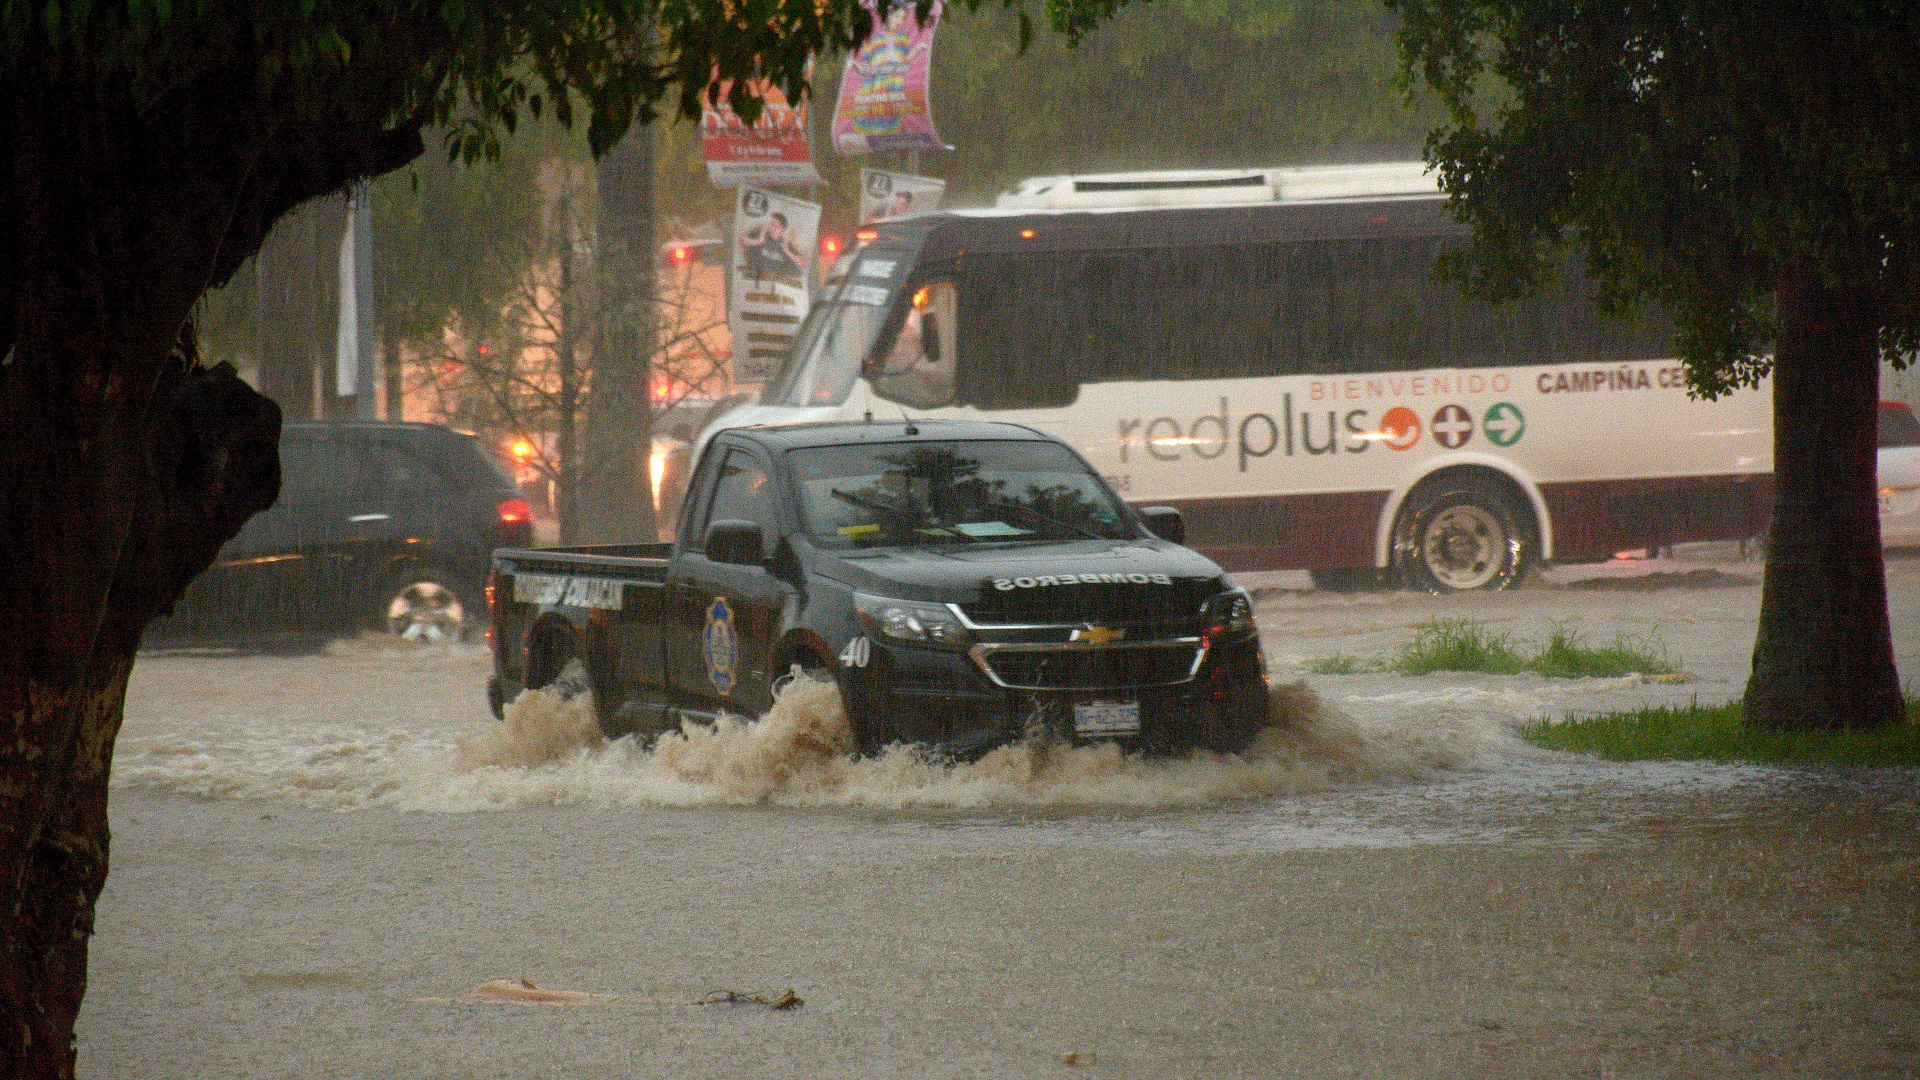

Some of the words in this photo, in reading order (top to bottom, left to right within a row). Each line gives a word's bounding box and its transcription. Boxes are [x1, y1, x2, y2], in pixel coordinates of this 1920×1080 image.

[1309, 373, 1511, 401] BIENVENIDO
[1536, 363, 1651, 394] CAMPIÑA
[1656, 366, 1689, 390] CE
[1117, 391, 1371, 472] redplus
[838, 635, 870, 668] 40
